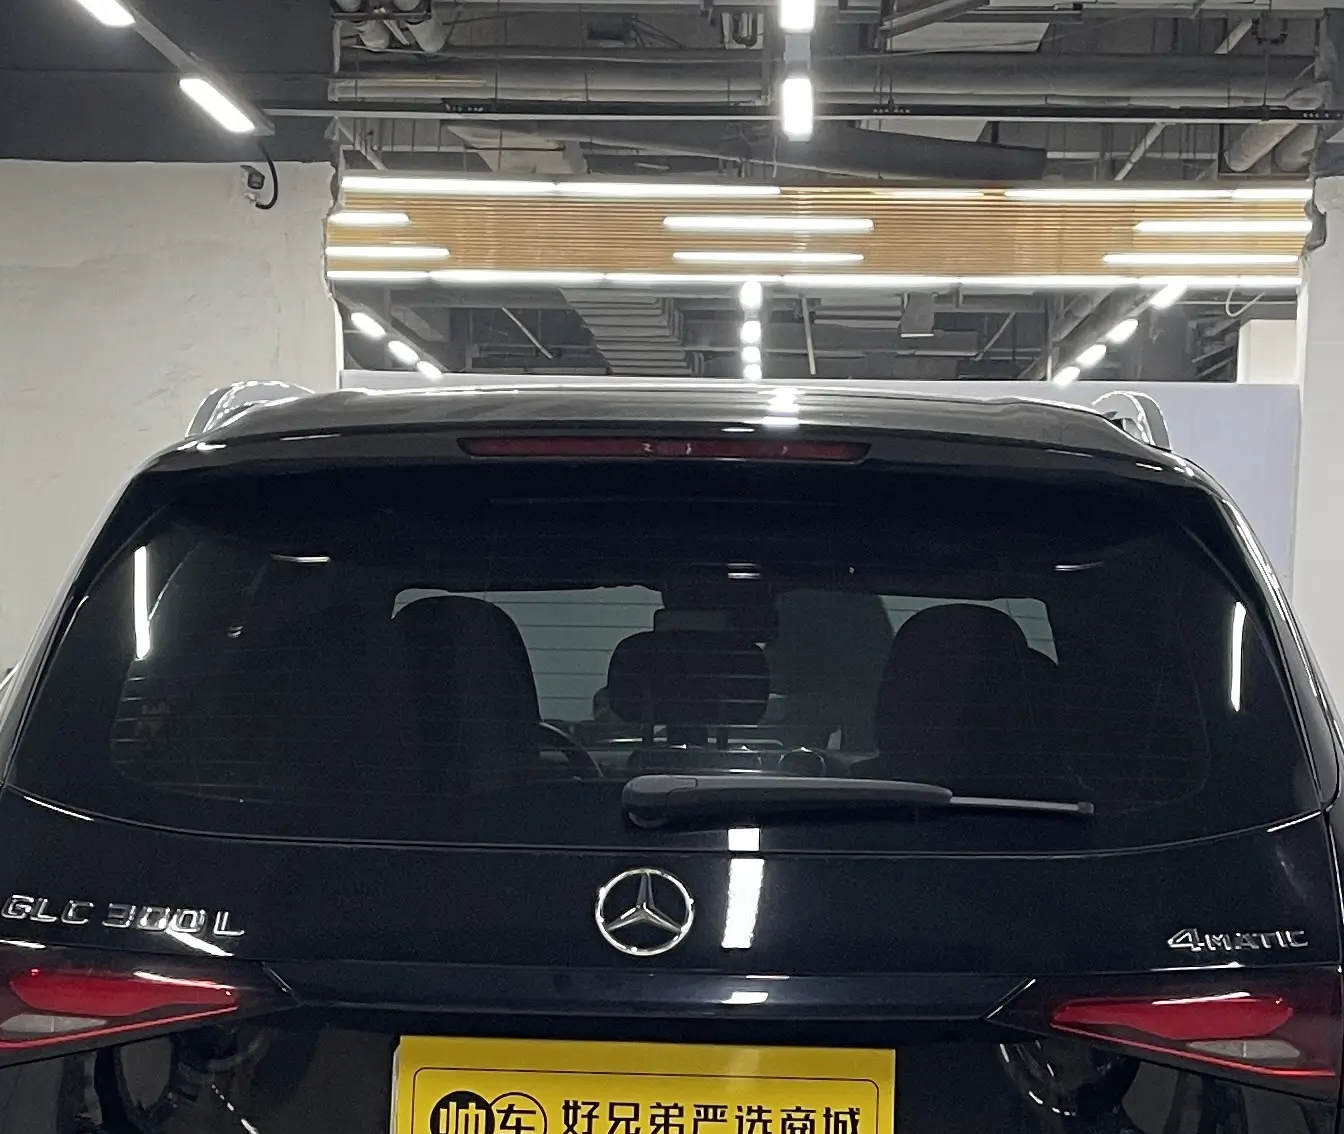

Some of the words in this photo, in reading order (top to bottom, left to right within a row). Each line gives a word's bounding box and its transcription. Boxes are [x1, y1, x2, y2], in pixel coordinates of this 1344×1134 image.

[1, 894, 94, 924] GLC
[102, 903, 206, 934] 300
[212, 911, 245, 937] L
[1168, 928, 1308, 951] 4MATIC
